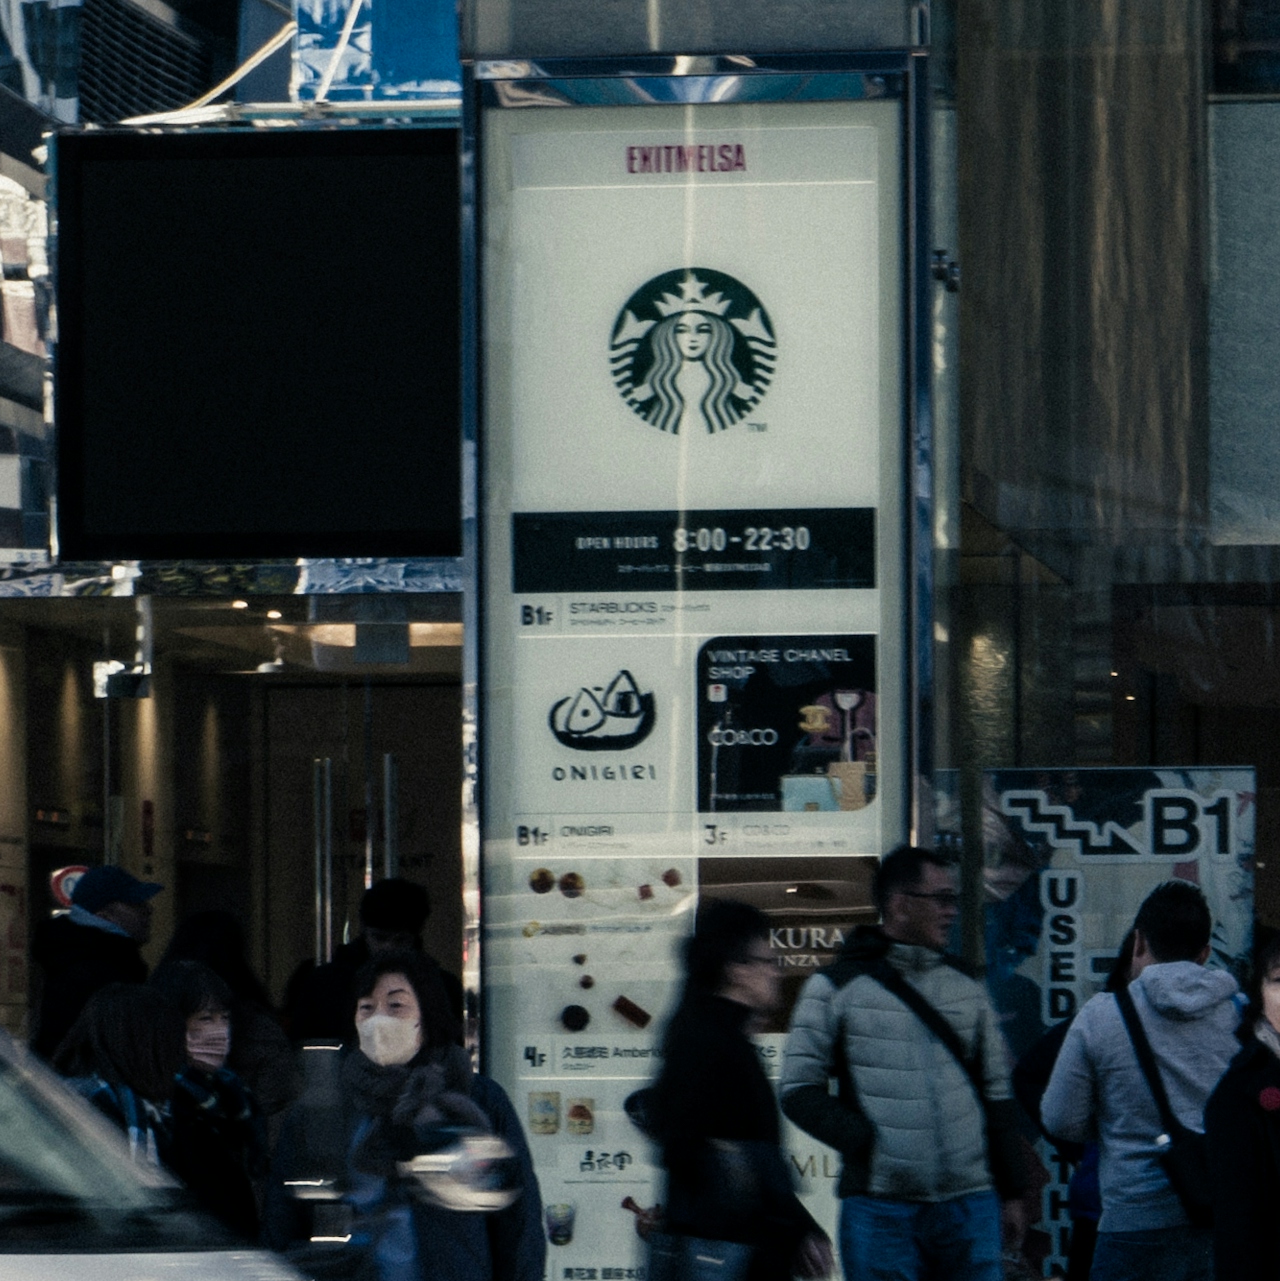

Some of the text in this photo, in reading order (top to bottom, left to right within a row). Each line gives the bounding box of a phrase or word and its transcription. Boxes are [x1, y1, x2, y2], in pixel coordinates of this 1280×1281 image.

[570, 602, 657, 615] STARBUCKS
[708, 648, 852, 664] VINTAGE CHANEL
[708, 666, 756, 680] SHOP
[551, 765, 657, 782] ONIGIRI
[1153, 796, 1230, 855] B1
[1048, 877, 1077, 1018] USED
[777, 954, 821, 967] INZA
